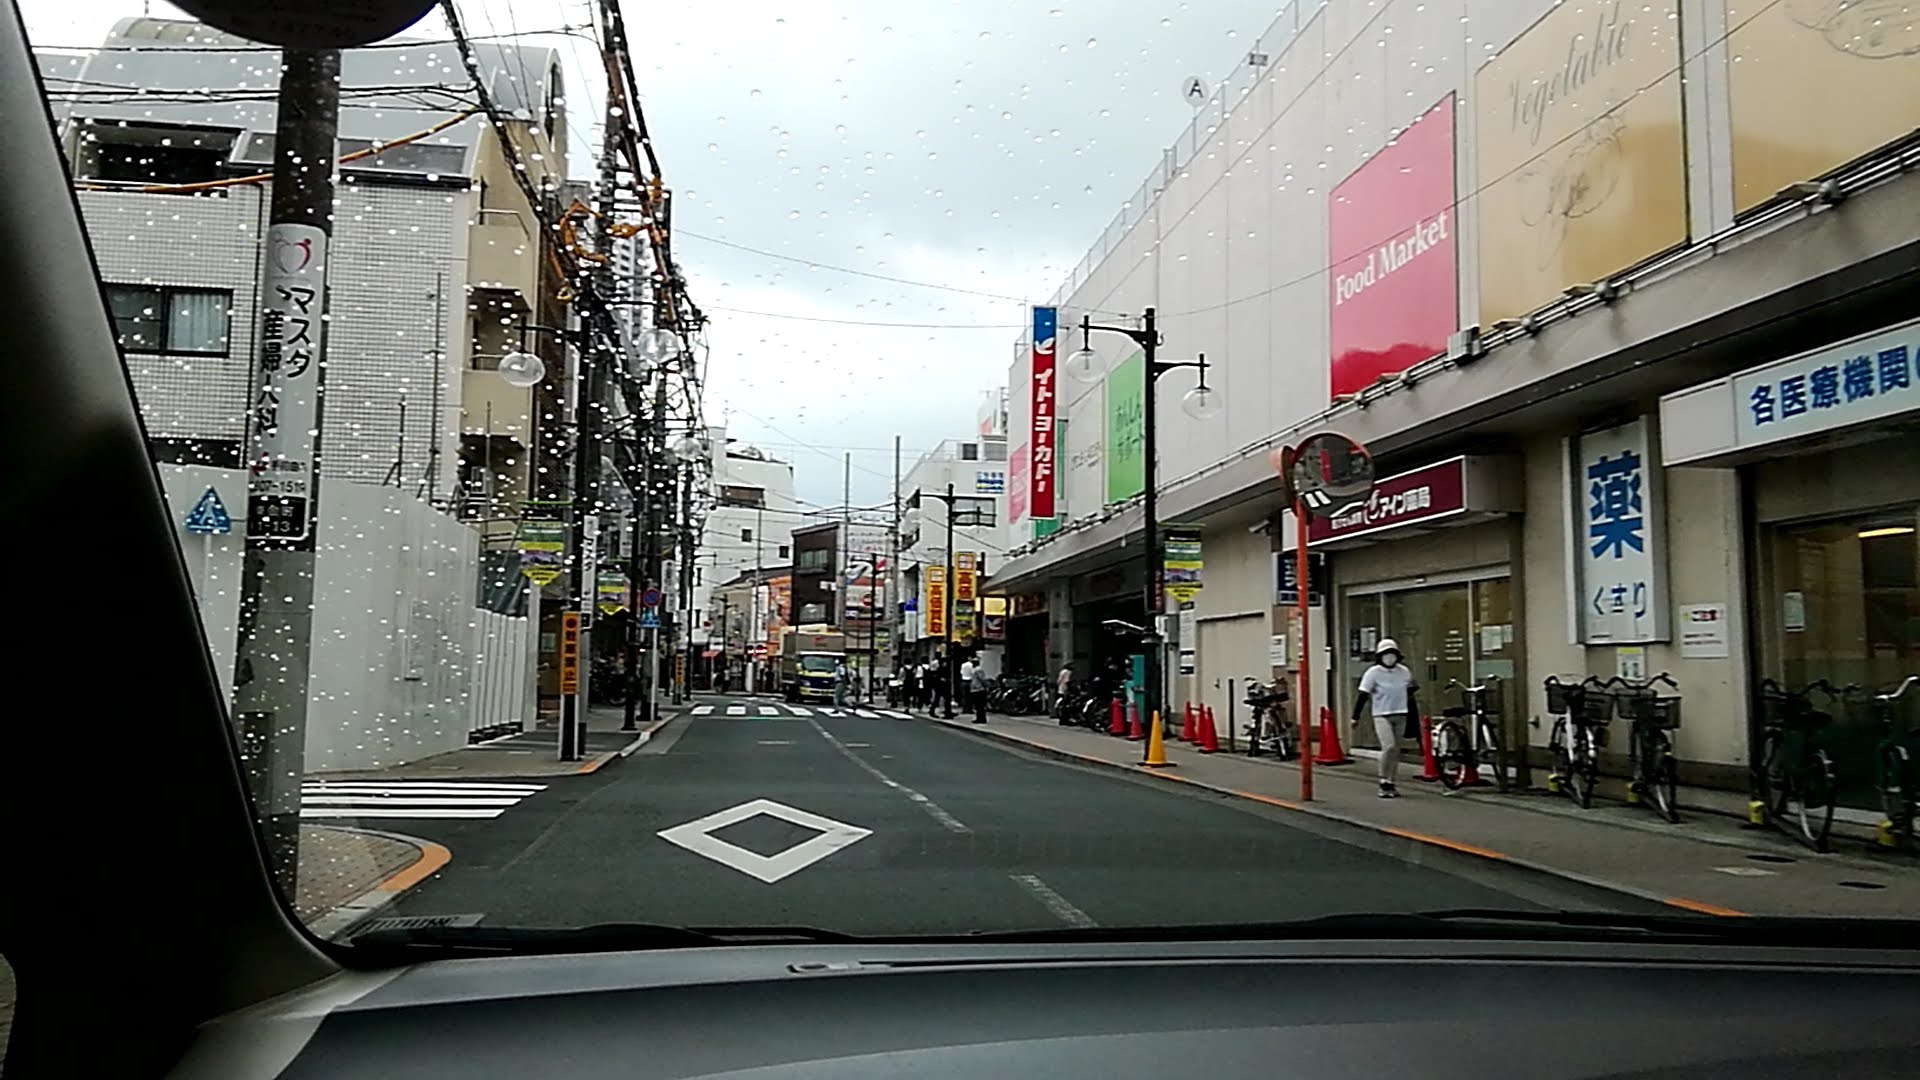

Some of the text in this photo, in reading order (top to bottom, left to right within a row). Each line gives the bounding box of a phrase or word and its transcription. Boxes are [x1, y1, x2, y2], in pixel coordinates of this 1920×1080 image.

[1189, 80, 1204, 98] A
[1508, 2, 1630, 147] Vegetable
[1336, 212, 1448, 305] Food Market
[1033, 368, 1054, 494] イトーヨーカドー
[1750, 345, 1920, 426] 各医療機関
[1587, 450, 1644, 560] 薬
